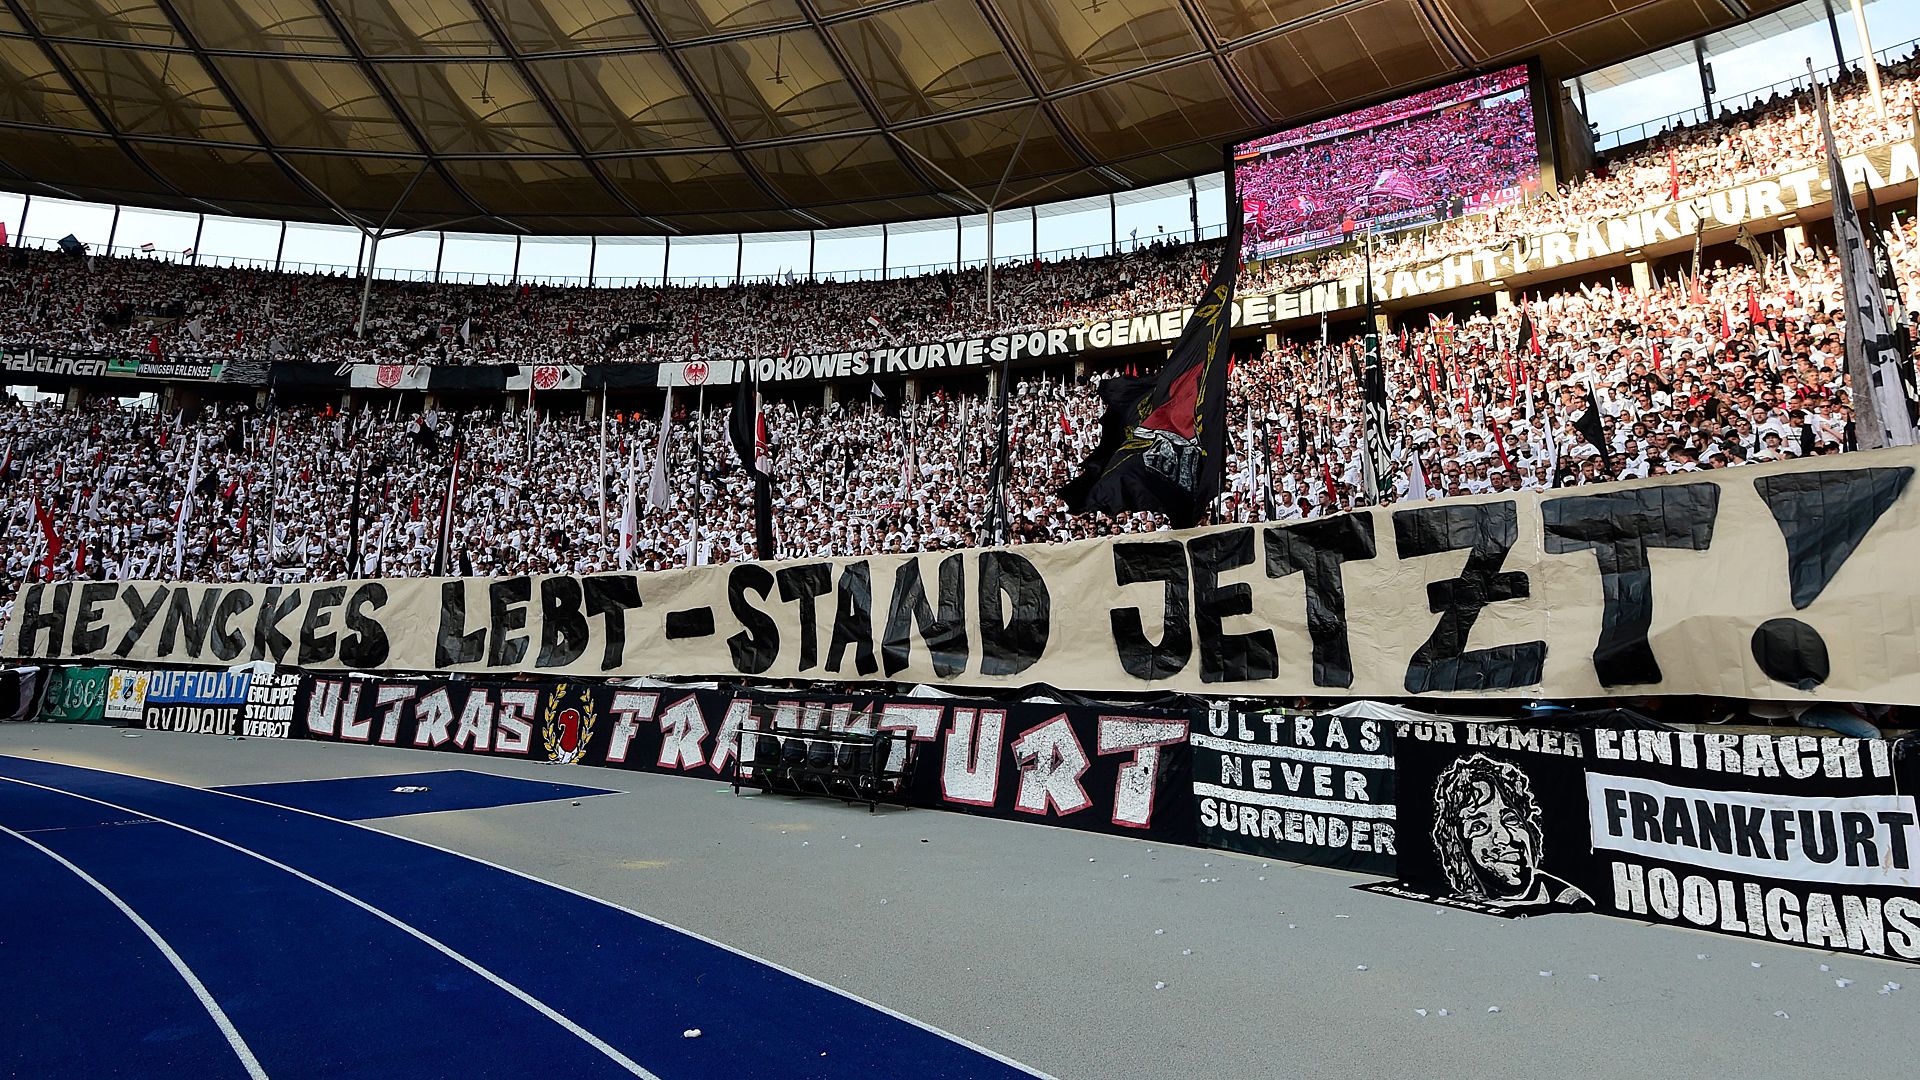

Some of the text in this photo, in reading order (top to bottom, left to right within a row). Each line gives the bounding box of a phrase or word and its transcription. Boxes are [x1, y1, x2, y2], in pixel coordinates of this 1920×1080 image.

[1276, 248, 1503, 318] EINTRACHT
[174, 364, 211, 377] ERLENSEE
[18, 581, 388, 668] HEYNCKES
[436, 575, 643, 672] LEBT
[727, 550, 1051, 678] STAND
[1110, 466, 1915, 694] JETZT!
[149, 671, 249, 699] DIFFIDATI
[247, 685, 298, 706] GRUPPE
[242, 719, 291, 738] VERBOT
[307, 678, 539, 755] ULTRAS
[1207, 702, 1382, 752] ULTRAS
[1467, 723, 1585, 759] IMMER
[1221, 754, 1370, 802] NEVER
[1594, 728, 1892, 780] EINTRACHT
[1200, 798, 1398, 856] SURRENDER
[1603, 787, 1915, 870] FRANKFURT
[1611, 861, 1920, 959] HOOLIGANS
